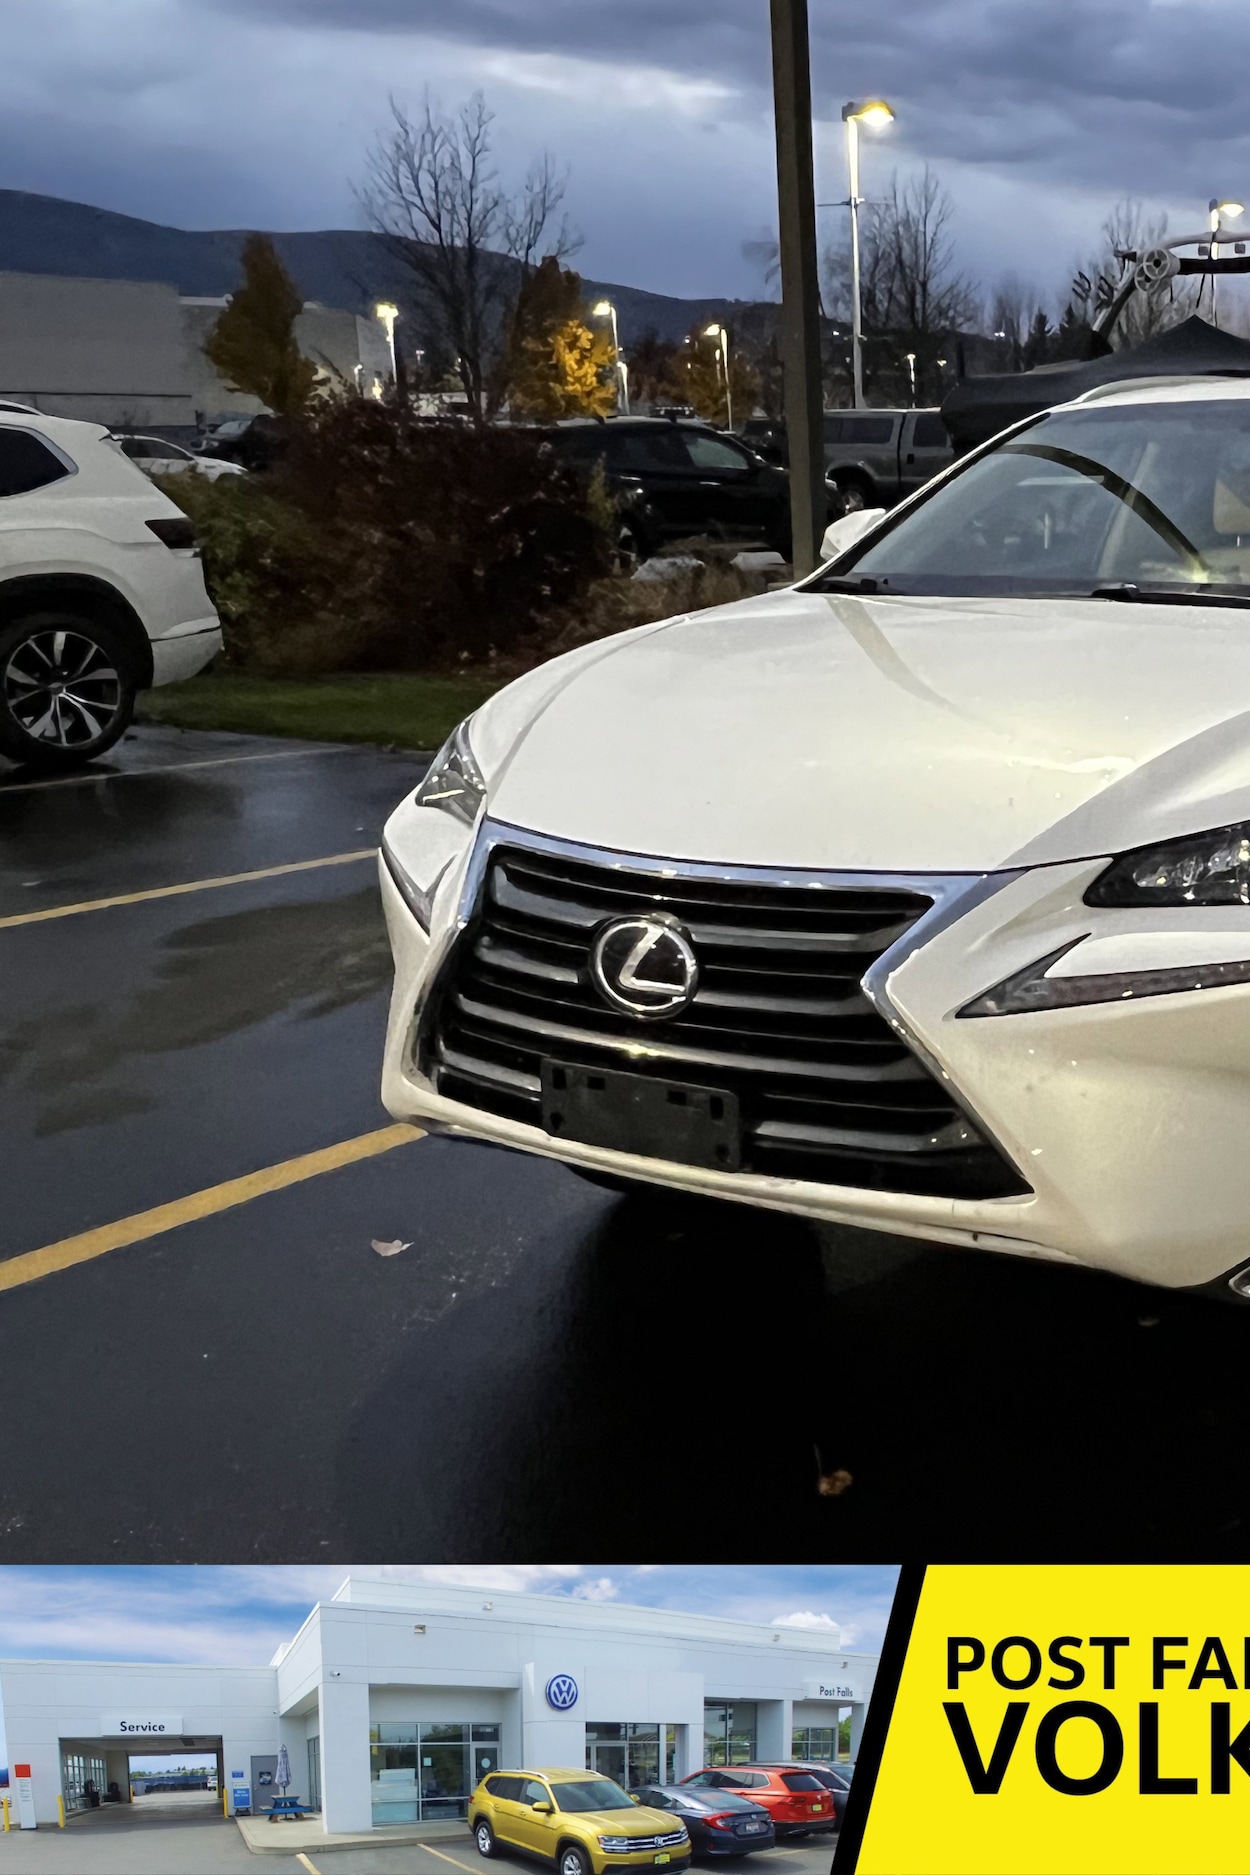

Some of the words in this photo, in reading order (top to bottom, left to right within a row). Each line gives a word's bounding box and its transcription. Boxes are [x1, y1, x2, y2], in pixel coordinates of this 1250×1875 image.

[819, 1685, 835, 1697] Post
[836, 1686, 854, 1698] Falls
[119, 1720, 166, 1732] Service
